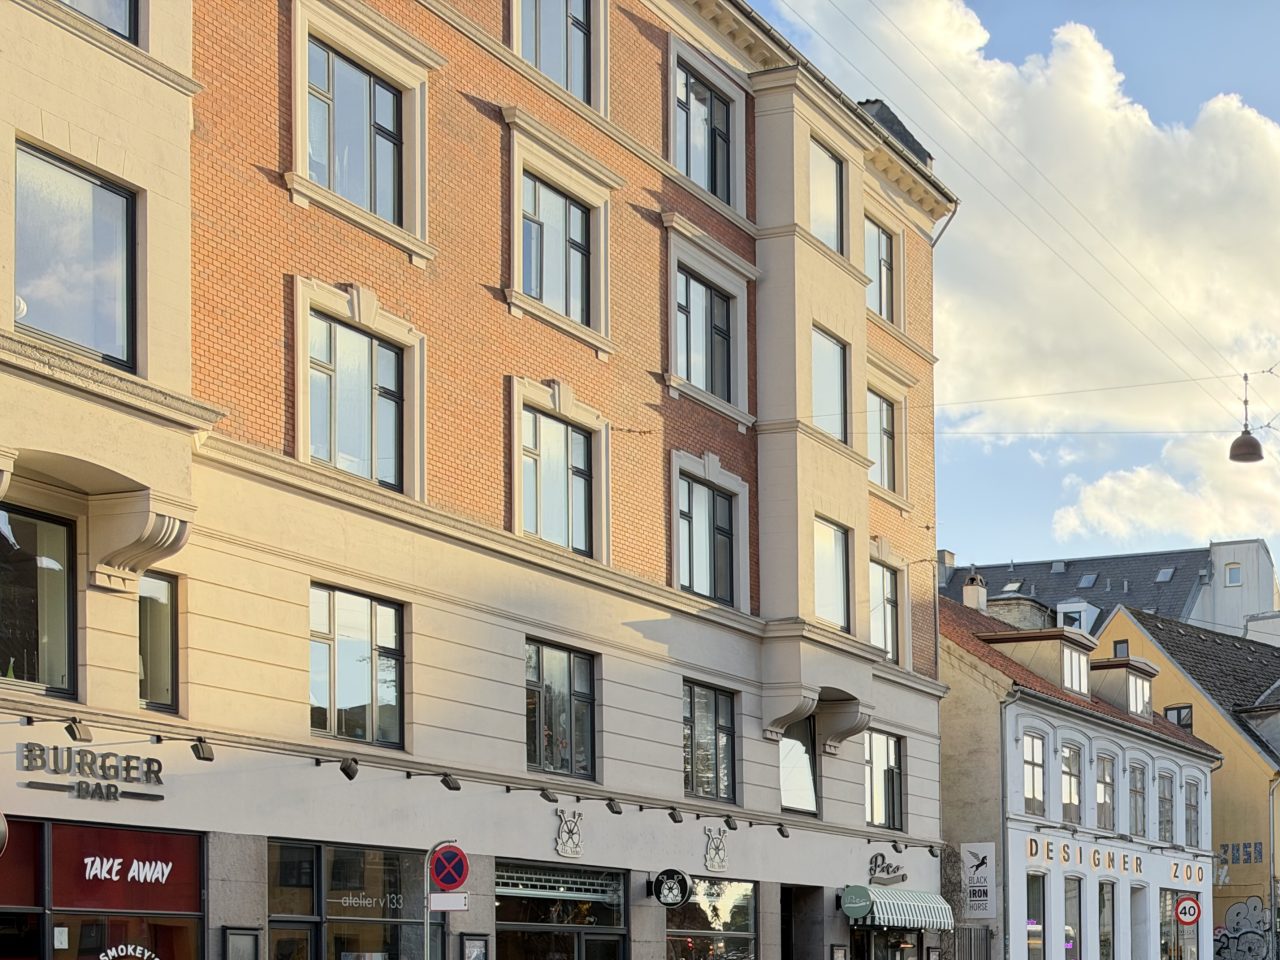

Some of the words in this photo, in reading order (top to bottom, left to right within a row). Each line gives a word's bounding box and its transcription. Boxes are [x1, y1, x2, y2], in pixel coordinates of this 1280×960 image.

[23, 742, 164, 785] BURGER
[76, 780, 120, 801] BAR
[1027, 837, 1143, 874] DESIGNER
[1172, 862, 1204, 882] ZOO
[84, 856, 123, 881] TAKE
[128, 859, 173, 884] AWAY
[968, 876, 988, 885] BLACK
[341, 891, 377, 908] atelier
[379, 893, 404, 909] v133
[969, 888, 988, 899] IRON
[969, 902, 988, 912] HORSE
[1179, 905, 1196, 917] 40
